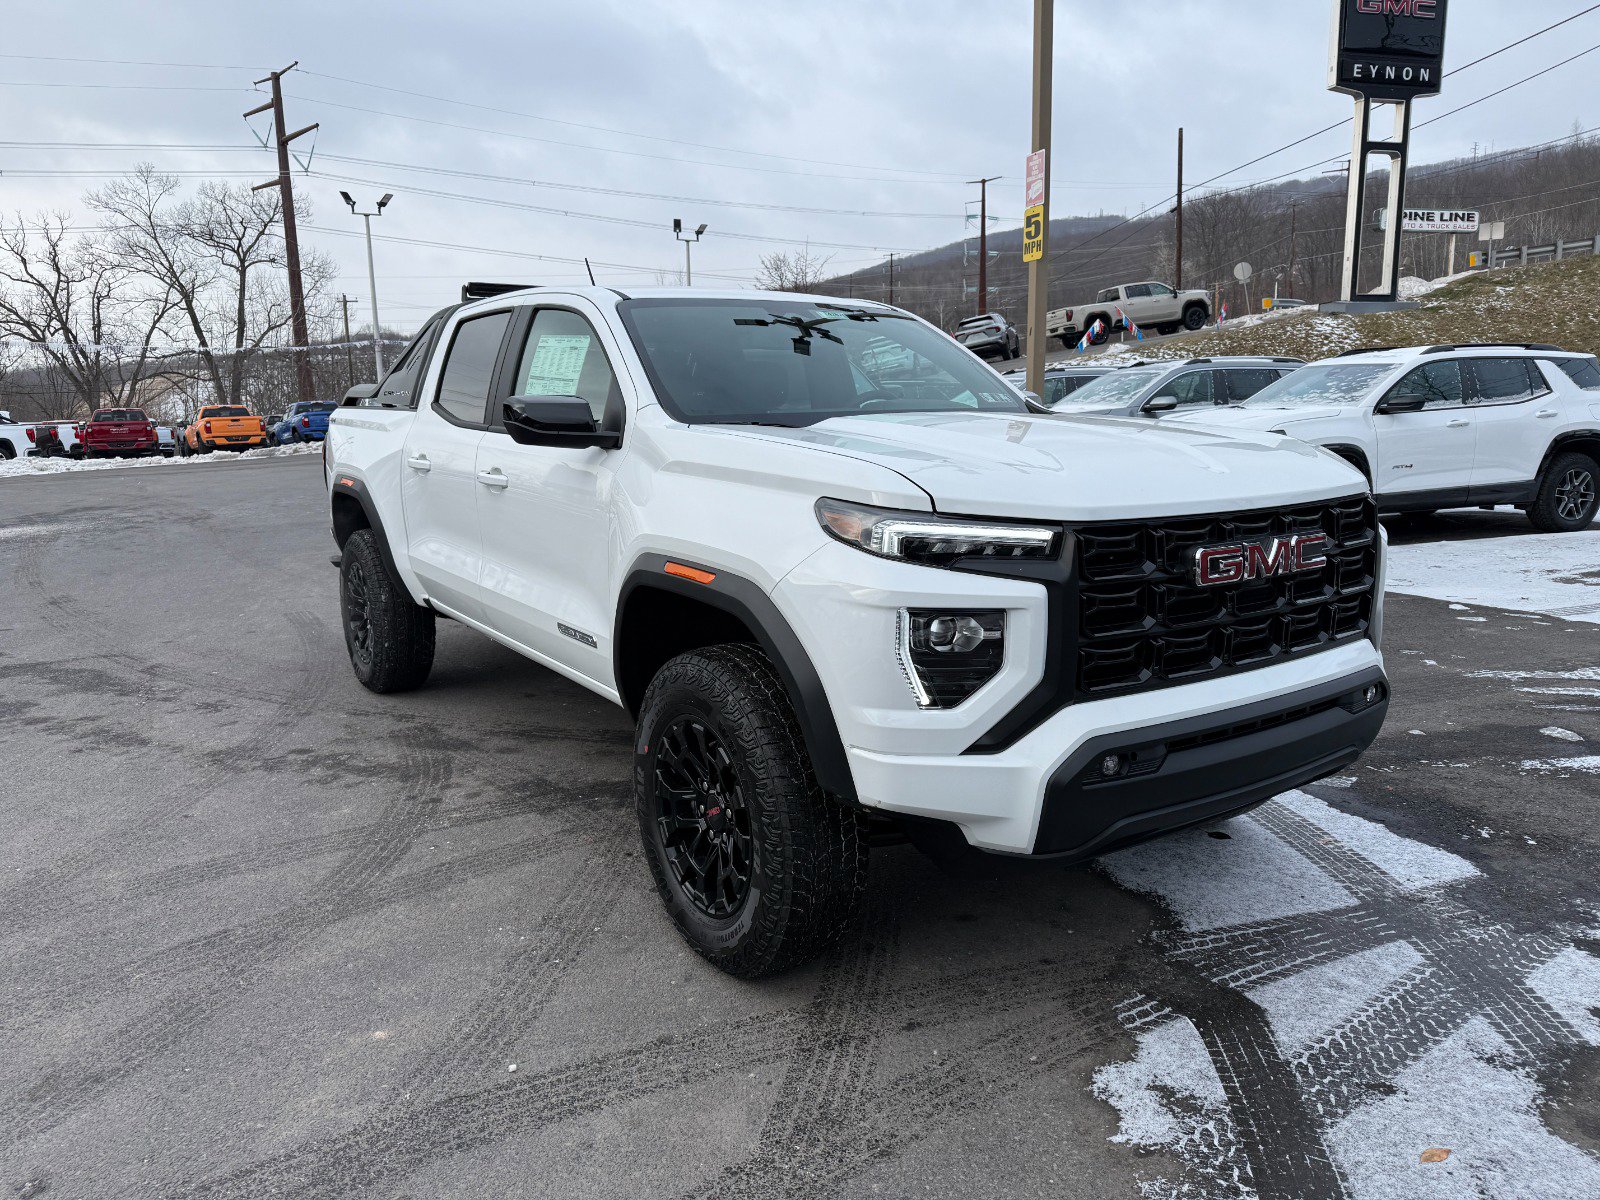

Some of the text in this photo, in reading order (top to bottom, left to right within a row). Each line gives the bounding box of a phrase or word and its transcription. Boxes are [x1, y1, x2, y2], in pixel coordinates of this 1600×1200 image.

[1357, 0, 1436, 18] GMC
[1353, 63, 1430, 82] EYNON
[1440, 212, 1475, 222] LINE
[1025, 212, 1041, 241] 5
[1023, 240, 1042, 255] MPH
[1195, 532, 1327, 587] GMC
